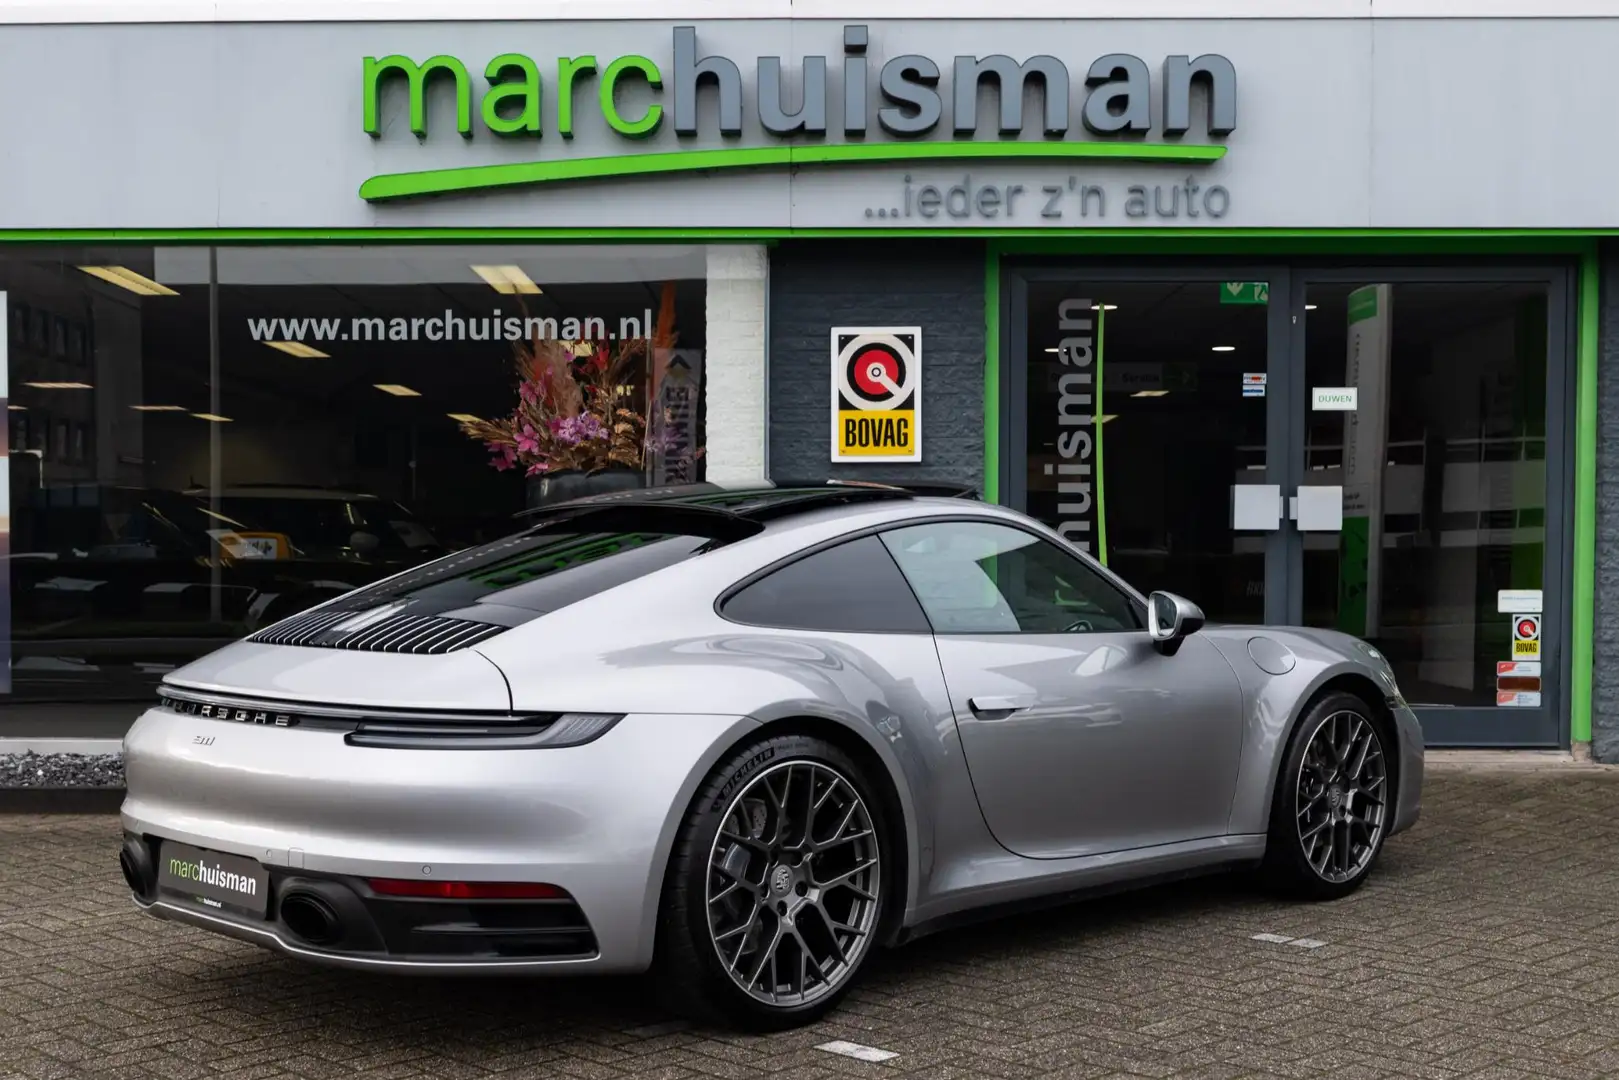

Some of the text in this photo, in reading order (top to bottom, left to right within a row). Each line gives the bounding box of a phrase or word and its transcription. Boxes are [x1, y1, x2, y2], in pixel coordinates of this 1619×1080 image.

[363, 26, 1237, 138] marchuisman
[865, 175, 1231, 219] ...ieder z'n auto
[247, 309, 652, 341] www.marchuisman.nl
[1318, 395, 1352, 403] DUWEN
[845, 418, 908, 447] BOVAG
[1516, 642, 1537, 652] BOVAG
[169, 857, 256, 895] marchuisman
